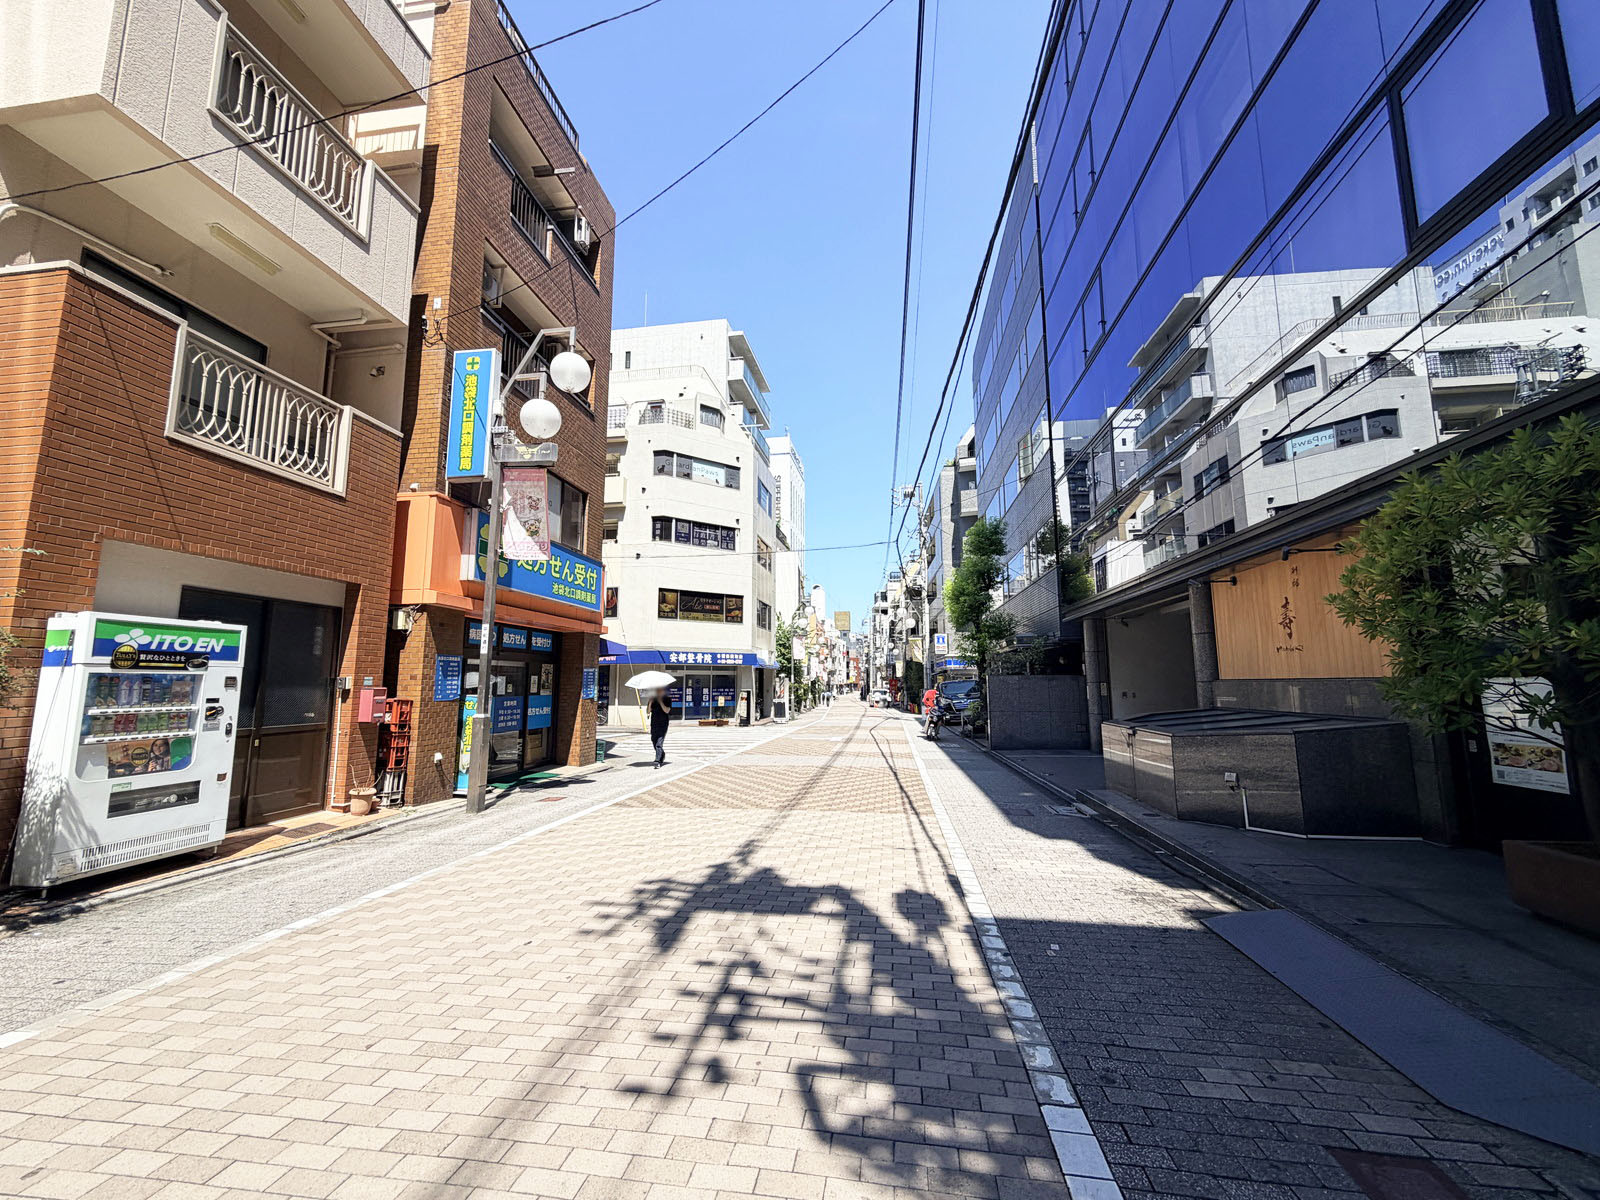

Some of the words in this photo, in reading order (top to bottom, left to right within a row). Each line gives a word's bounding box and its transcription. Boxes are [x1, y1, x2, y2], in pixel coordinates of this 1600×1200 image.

[460, 374, 477, 471] 池袋北口調剤薬局
[150, 635, 193, 651] ITO
[194, 637, 225, 653] EN
[503, 633, 526, 645] 処方せん
[669, 652, 712, 663] 安部整骨院
